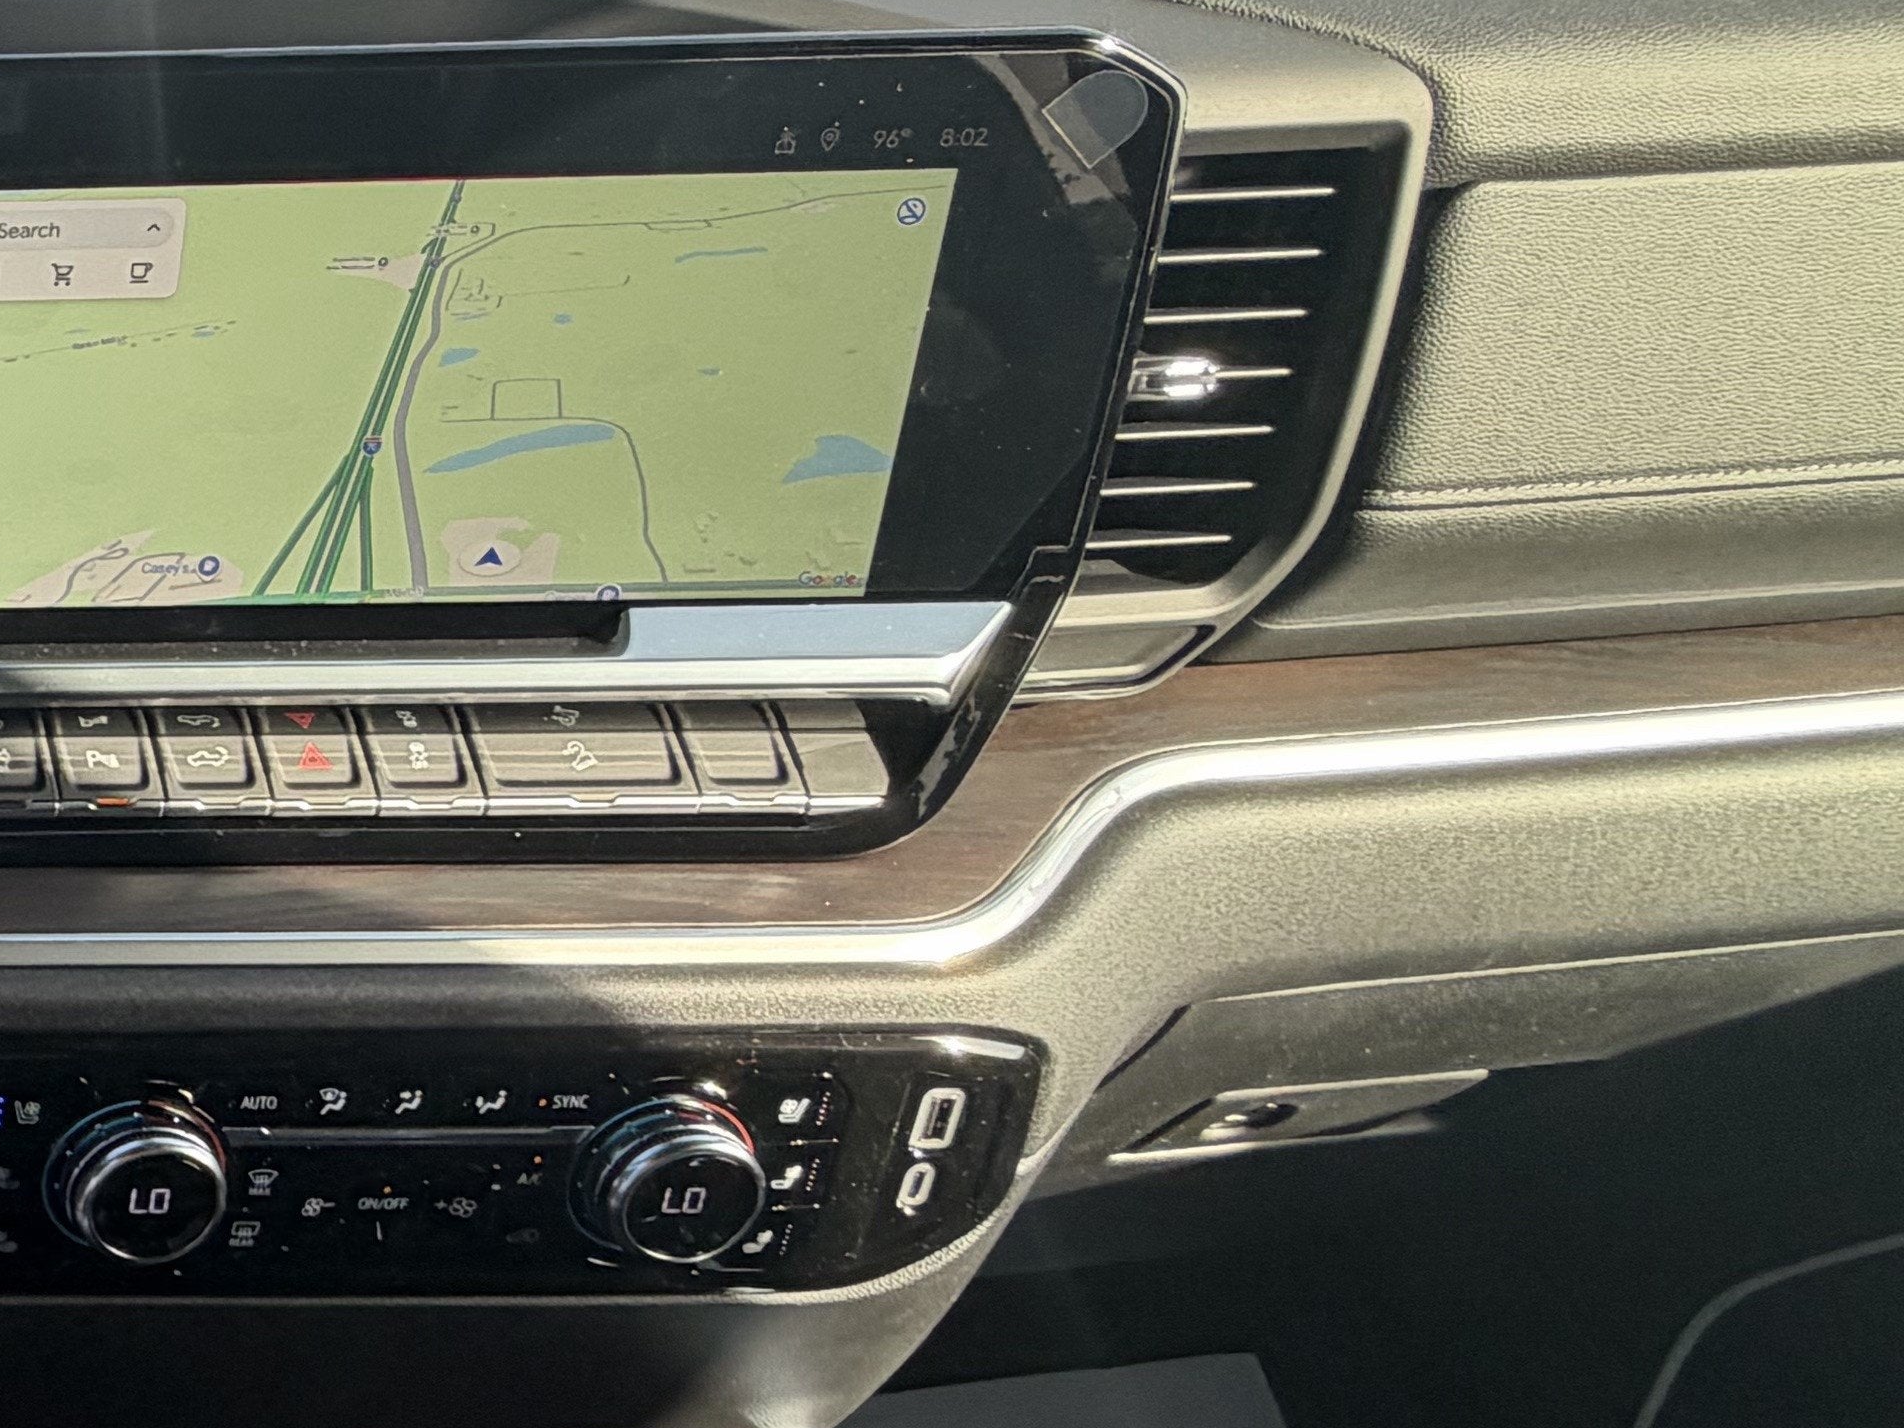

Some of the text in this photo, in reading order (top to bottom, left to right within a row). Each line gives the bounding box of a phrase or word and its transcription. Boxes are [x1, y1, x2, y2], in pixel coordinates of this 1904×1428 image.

[939, 128, 989, 148] 8:02
[240, 1095, 278, 1110] AUTO
[552, 1095, 590, 1109] SYNC
[357, 1197, 410, 1211] ON/OFF
